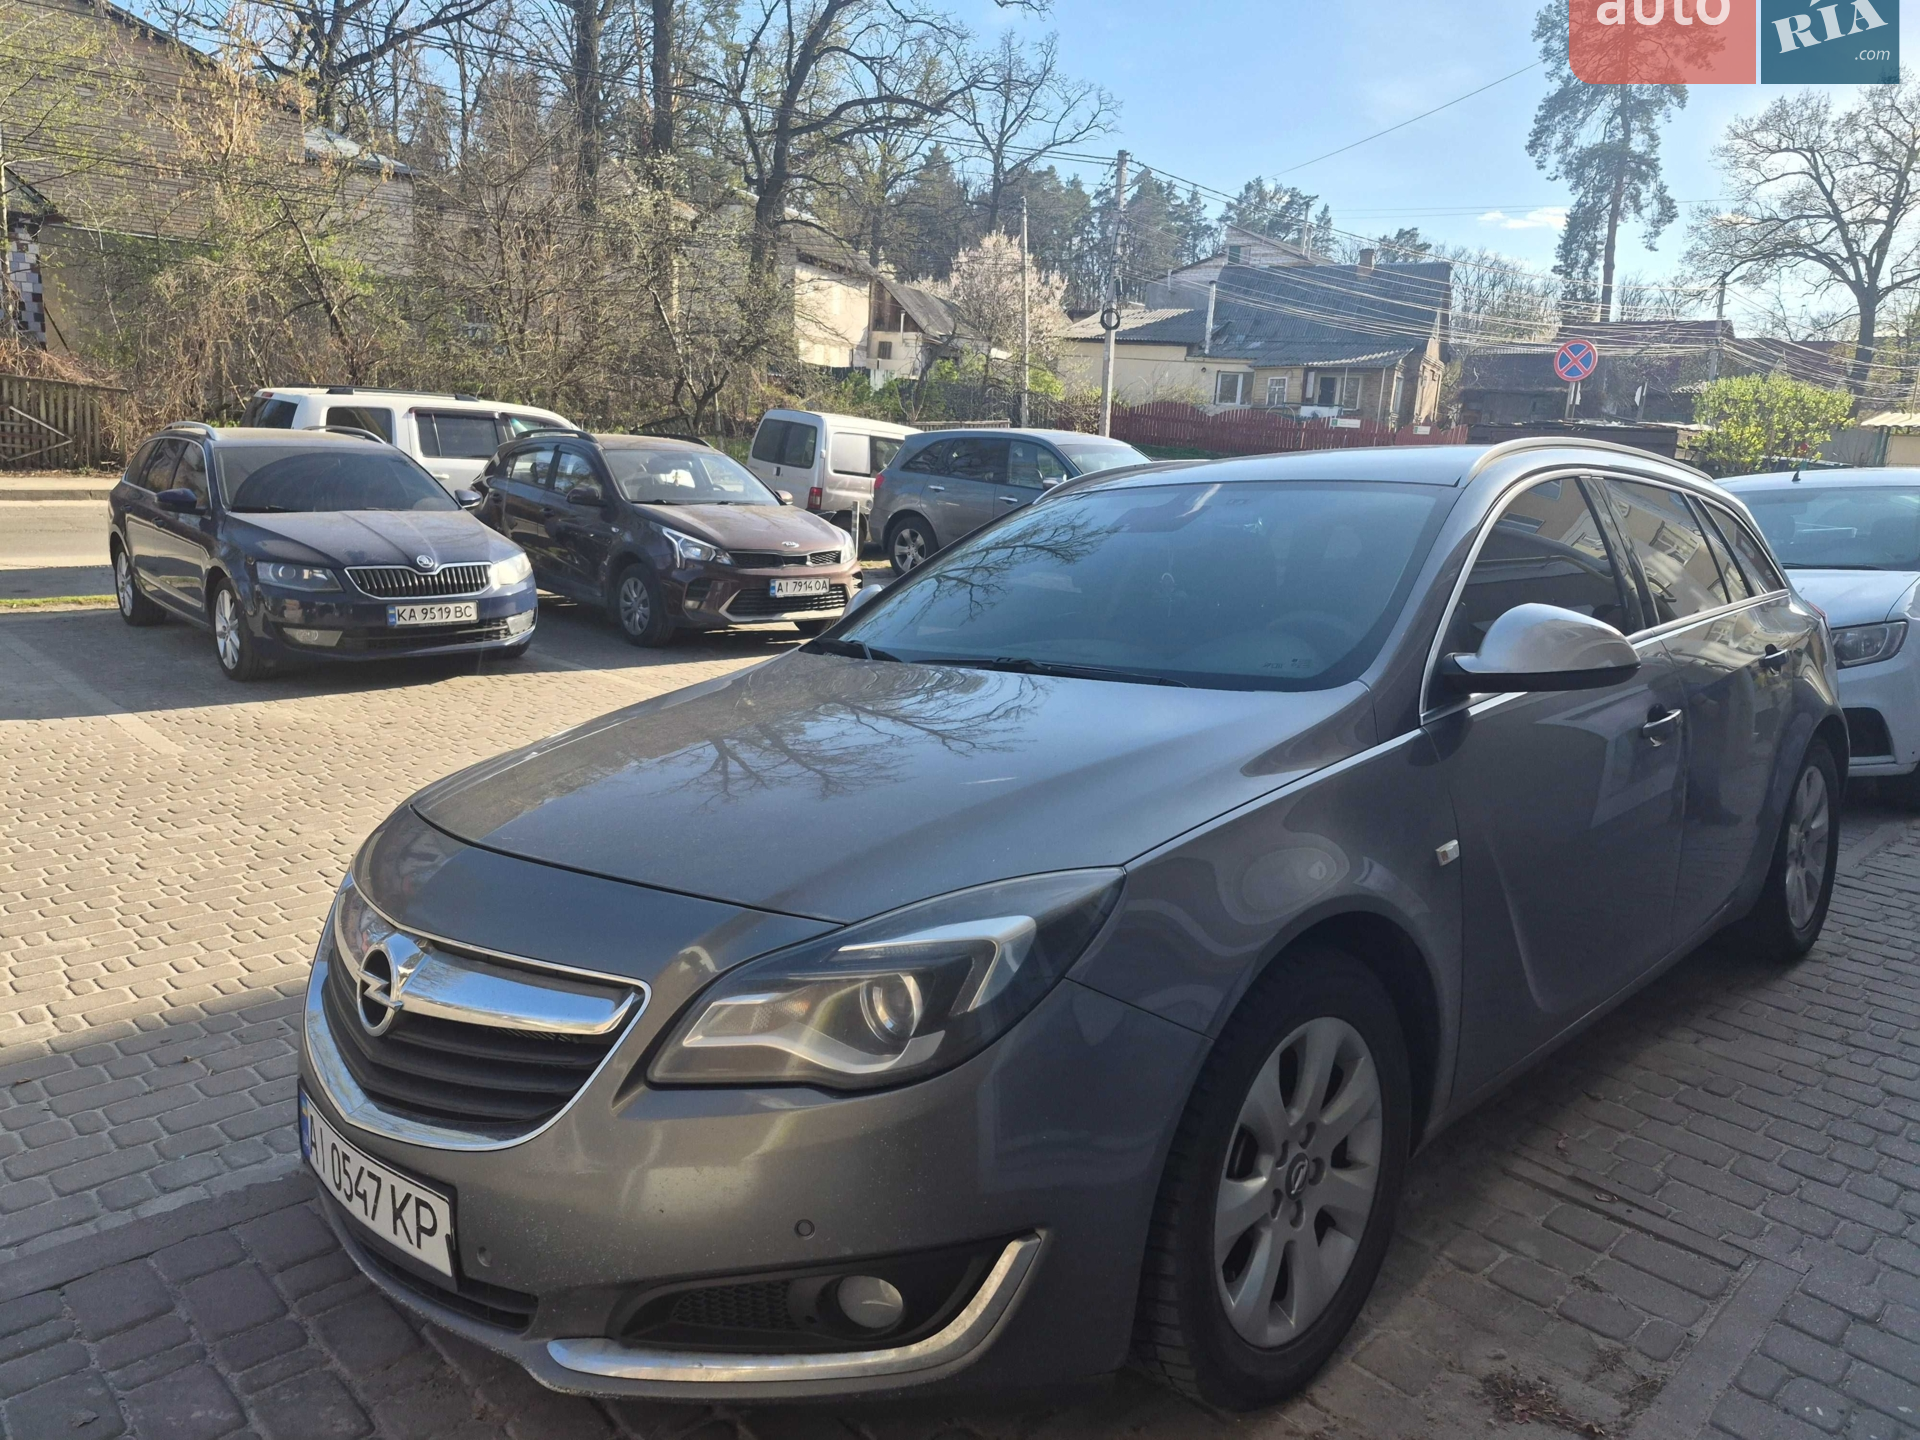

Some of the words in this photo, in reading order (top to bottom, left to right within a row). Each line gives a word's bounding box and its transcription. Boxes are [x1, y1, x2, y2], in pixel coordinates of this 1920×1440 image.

[777, 582, 788, 593] AI
[792, 581, 813, 592] 7914
[397, 608, 418, 622] KA
[421, 606, 452, 620] 9519
[454, 605, 473, 619] BC
[310, 1113, 326, 1174] AI
[331, 1142, 382, 1222] 0547
[390, 1183, 438, 1250] KP
